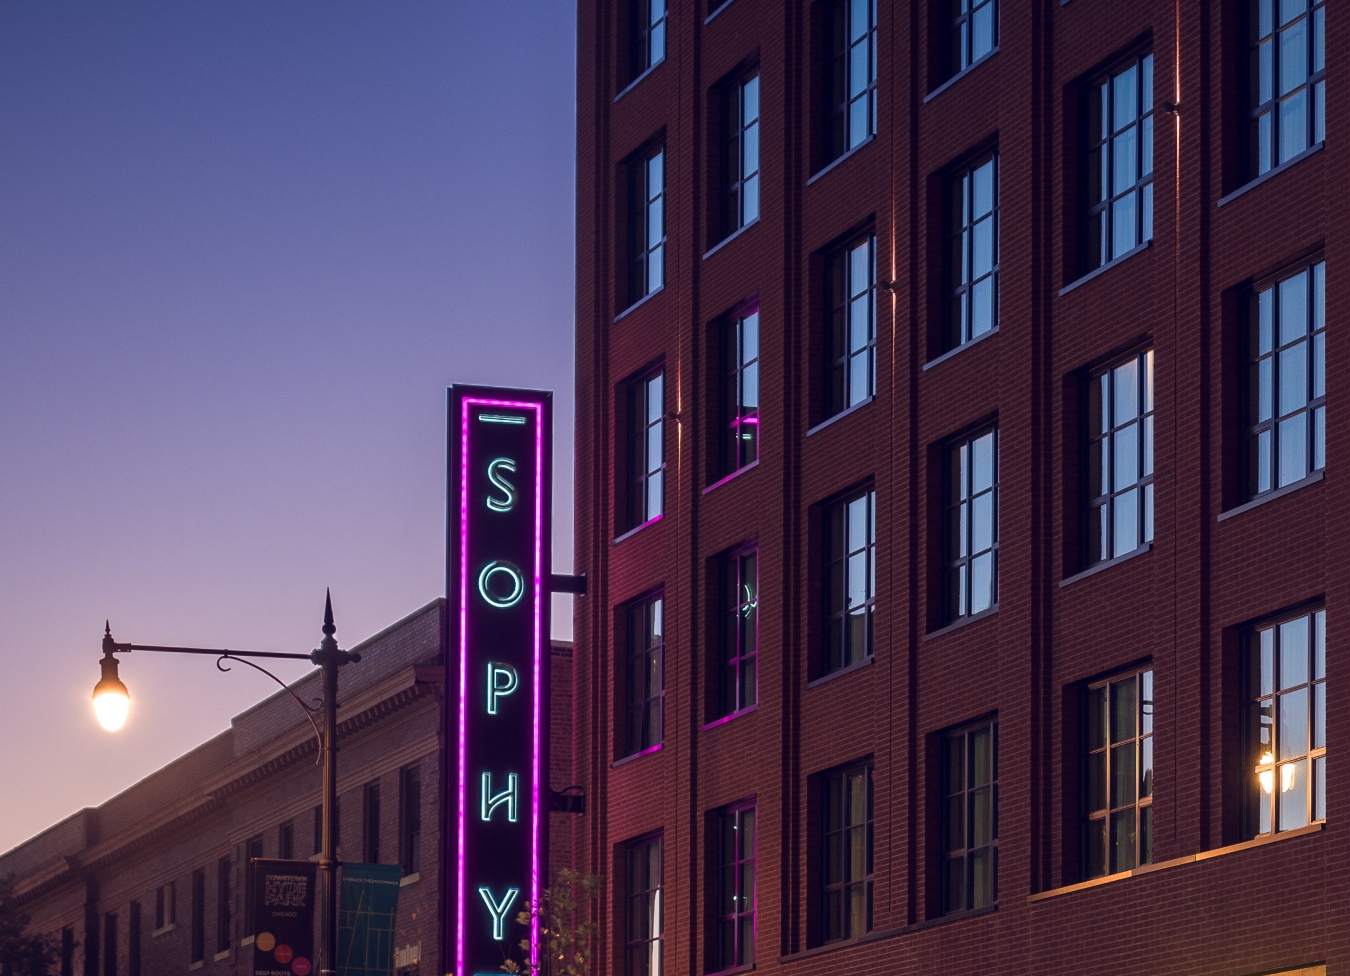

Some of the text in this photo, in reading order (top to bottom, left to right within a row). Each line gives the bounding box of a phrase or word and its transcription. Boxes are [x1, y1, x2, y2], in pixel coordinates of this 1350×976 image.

[478, 456, 525, 941] SOPHY
[265, 881, 307, 895] HYDE
[264, 893, 306, 907] PARK
